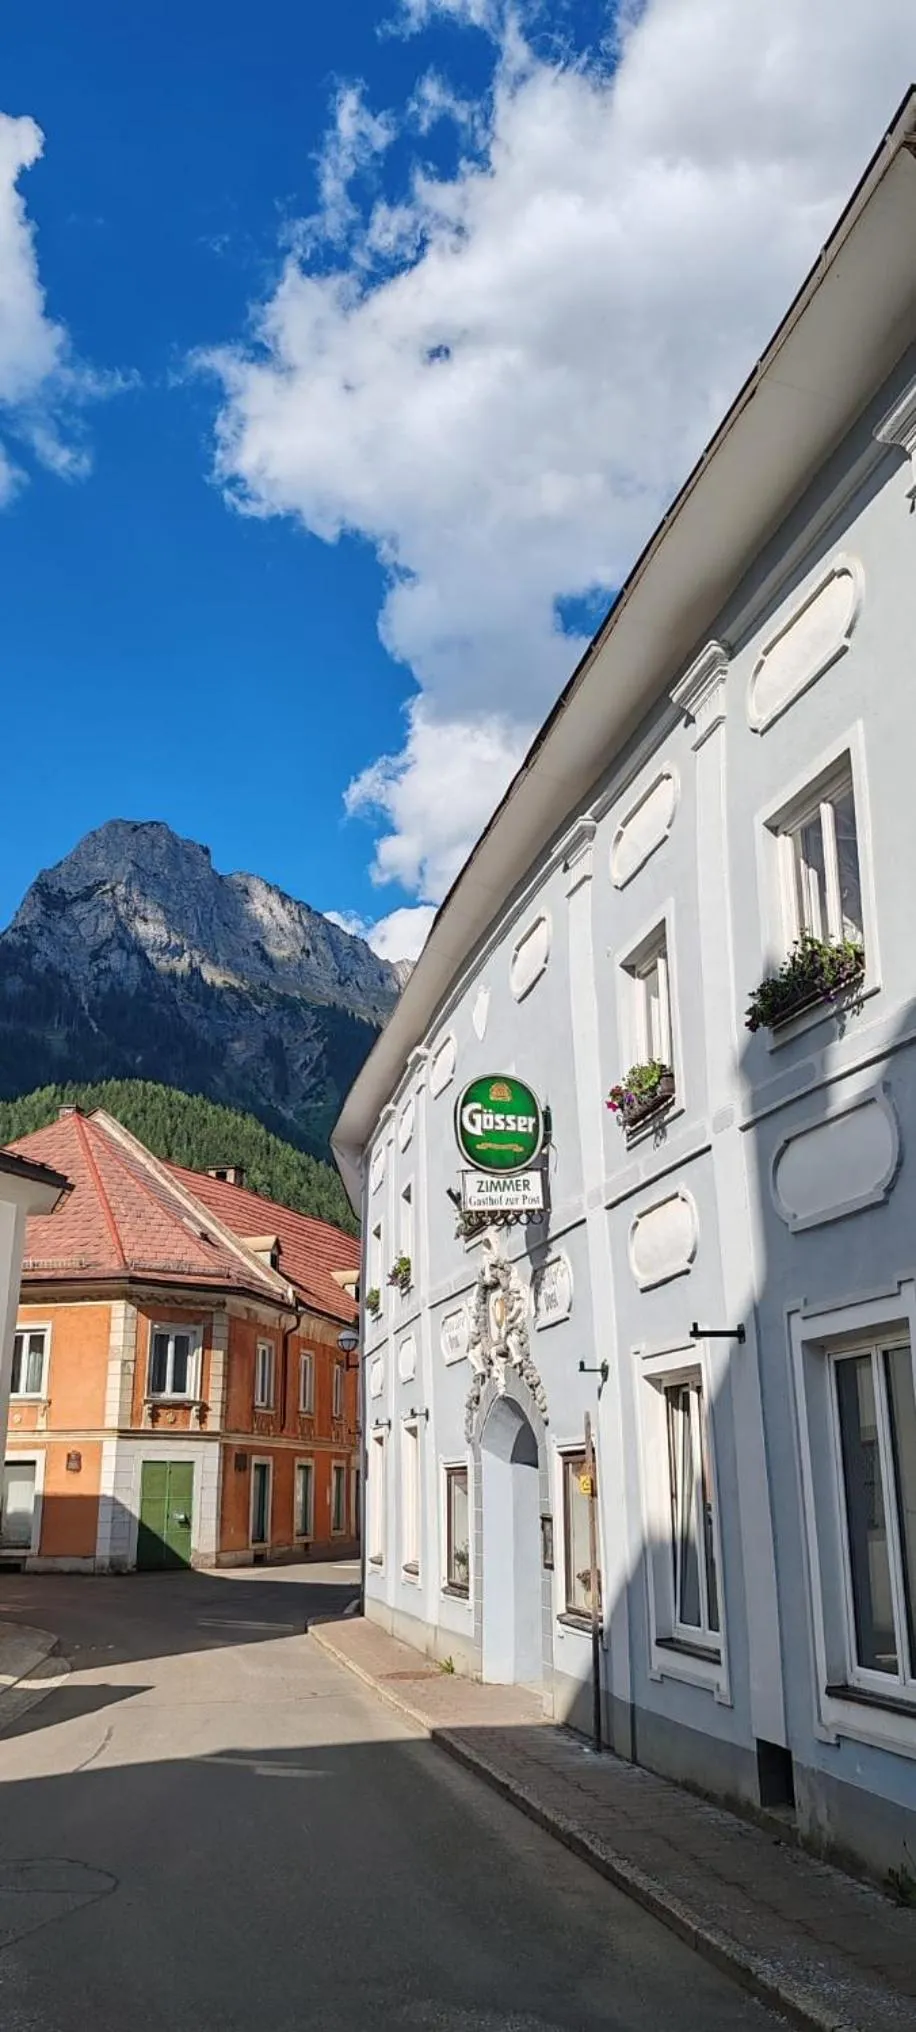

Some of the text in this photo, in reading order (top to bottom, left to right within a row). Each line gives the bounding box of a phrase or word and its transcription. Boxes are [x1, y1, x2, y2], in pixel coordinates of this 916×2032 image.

[462, 1102, 536, 1136] Gösser
[476, 1179, 531, 1193] ZIMMER
[469, 1194, 540, 1206] Gasthof zur Post
